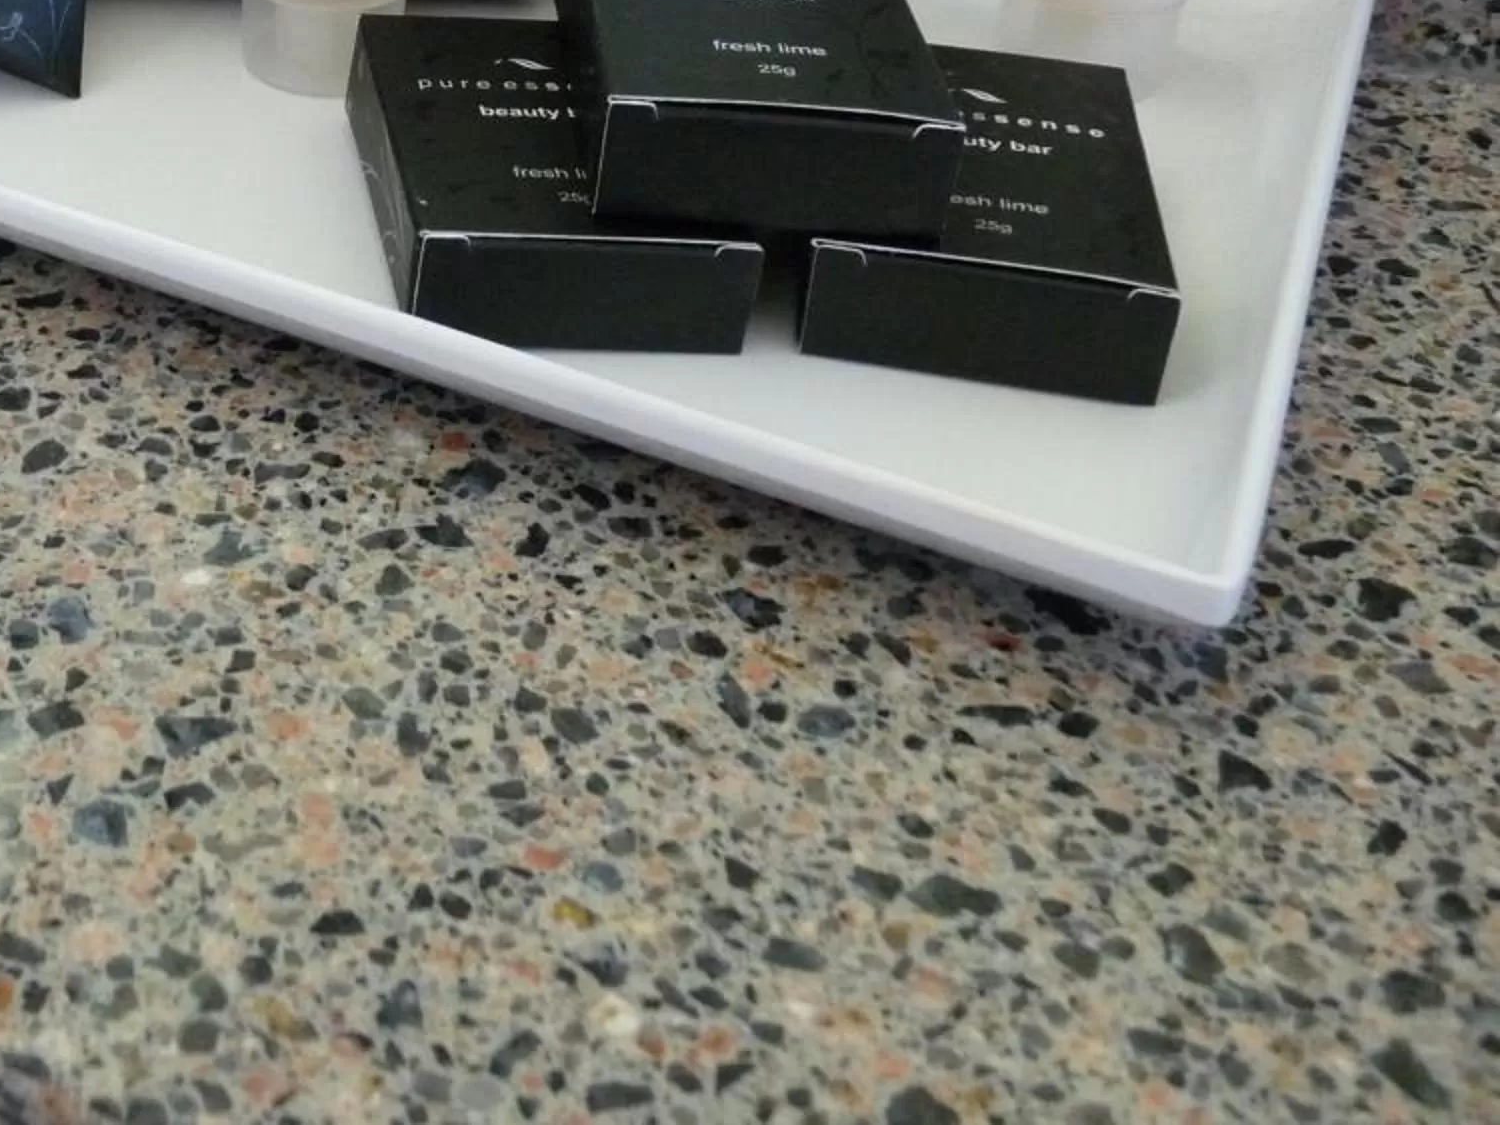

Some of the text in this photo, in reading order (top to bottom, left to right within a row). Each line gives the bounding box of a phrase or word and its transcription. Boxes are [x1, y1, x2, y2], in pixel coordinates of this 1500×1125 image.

[712, 38, 828, 57] fresh lime
[757, 63, 797, 78] 25g
[417, 78, 572, 92] pure ess
[479, 104, 560, 120] beauty
[958, 110, 1105, 138] ssense
[1010, 139, 1053, 156] bar
[512, 165, 569, 180] fresh
[999, 198, 1051, 215] lime
[974, 219, 1013, 235] 25g
